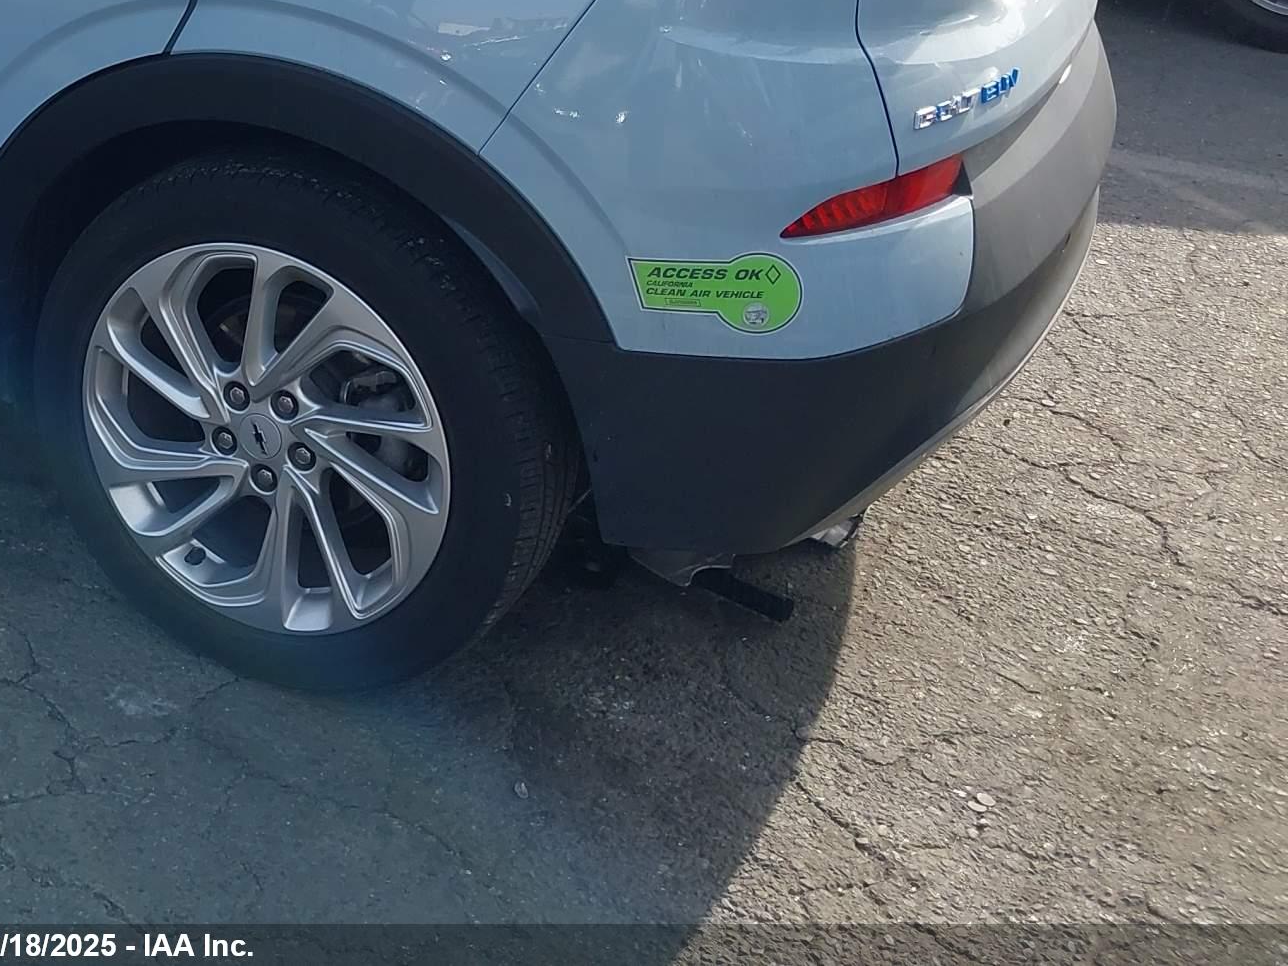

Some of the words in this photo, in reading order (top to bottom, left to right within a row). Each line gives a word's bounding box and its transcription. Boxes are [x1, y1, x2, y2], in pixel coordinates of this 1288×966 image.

[647, 266, 728, 280] ACCESS
[734, 268, 764, 281] OK
[646, 280, 693, 288] CALIFORNIA
[646, 287, 686, 296] CLEAN
[690, 289, 712, 298] AIR
[716, 290, 764, 299] VEHICLE
